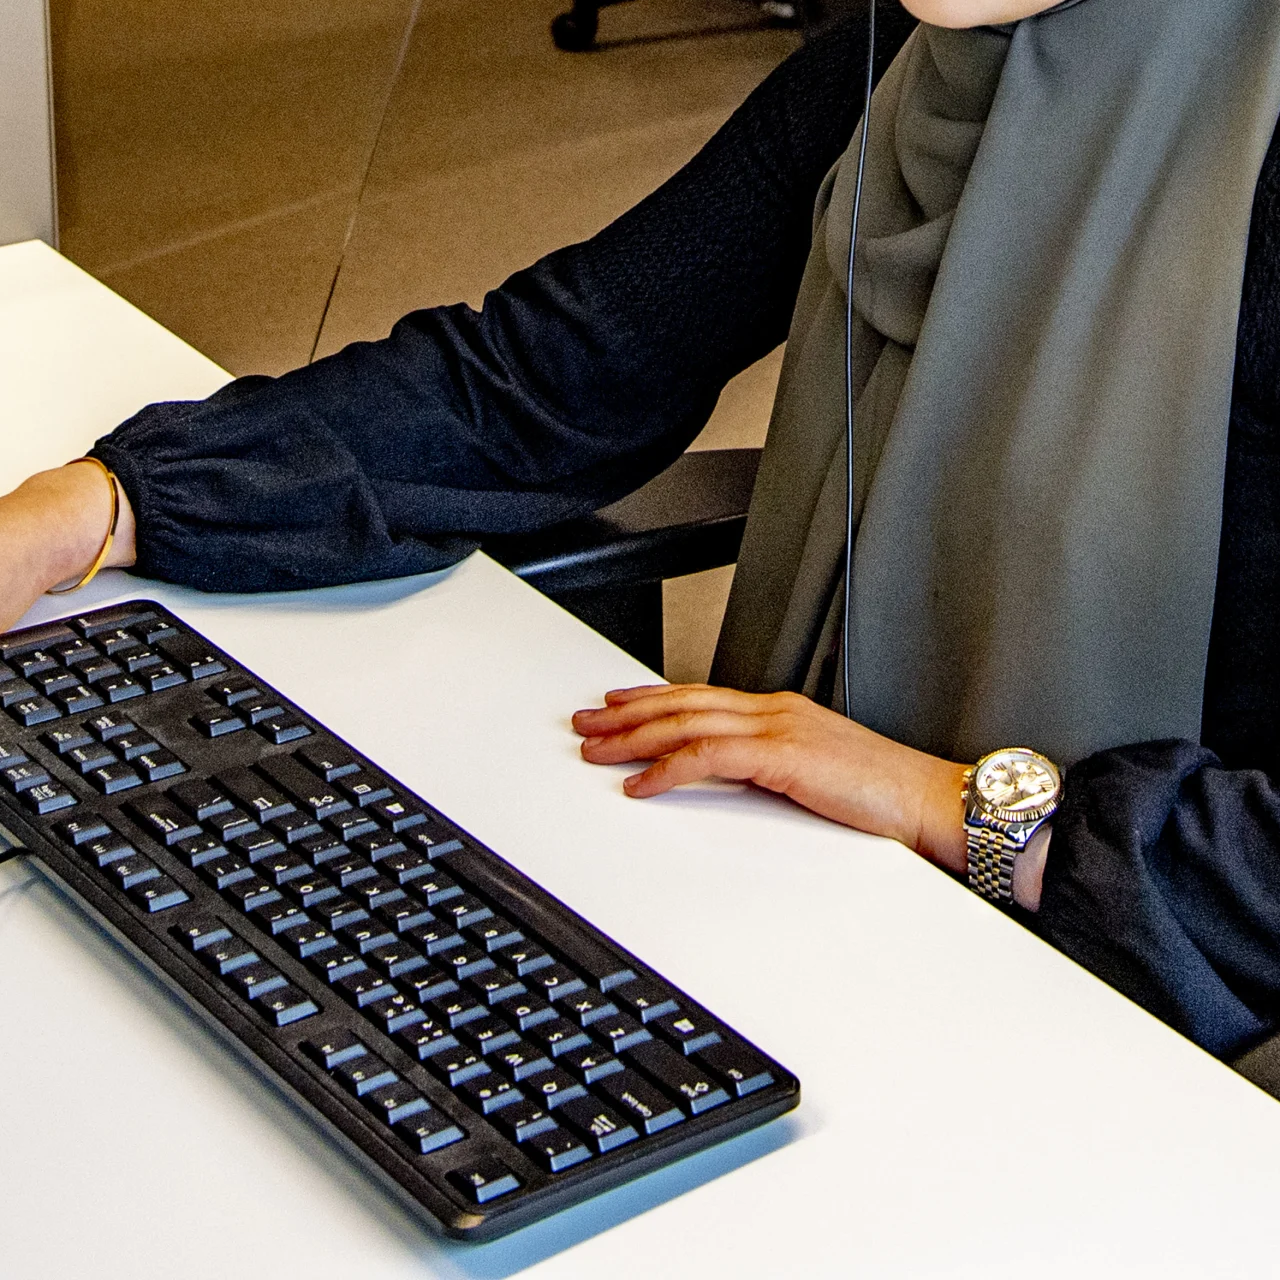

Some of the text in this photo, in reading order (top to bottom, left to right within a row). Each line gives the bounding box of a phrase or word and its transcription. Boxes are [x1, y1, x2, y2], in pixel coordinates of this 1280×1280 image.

[300, 885, 313, 893] O
[423, 883, 438, 892] M
[453, 907, 467, 915] N
[357, 932, 370, 940] U
[424, 933, 437, 941] H
[513, 954, 526, 962] V
[545, 977, 558, 985] C
[447, 1005, 461, 1013] R
[577, 1002, 591, 1011] X
[516, 1007, 530, 1015] D
[479, 1031, 492, 1039] E
[610, 1028, 624, 1037] Z
[549, 1033, 562, 1041] S
[505, 1054, 523, 1065] W
[581, 1058, 595, 1067] A
[543, 1082, 557, 1092] Q
